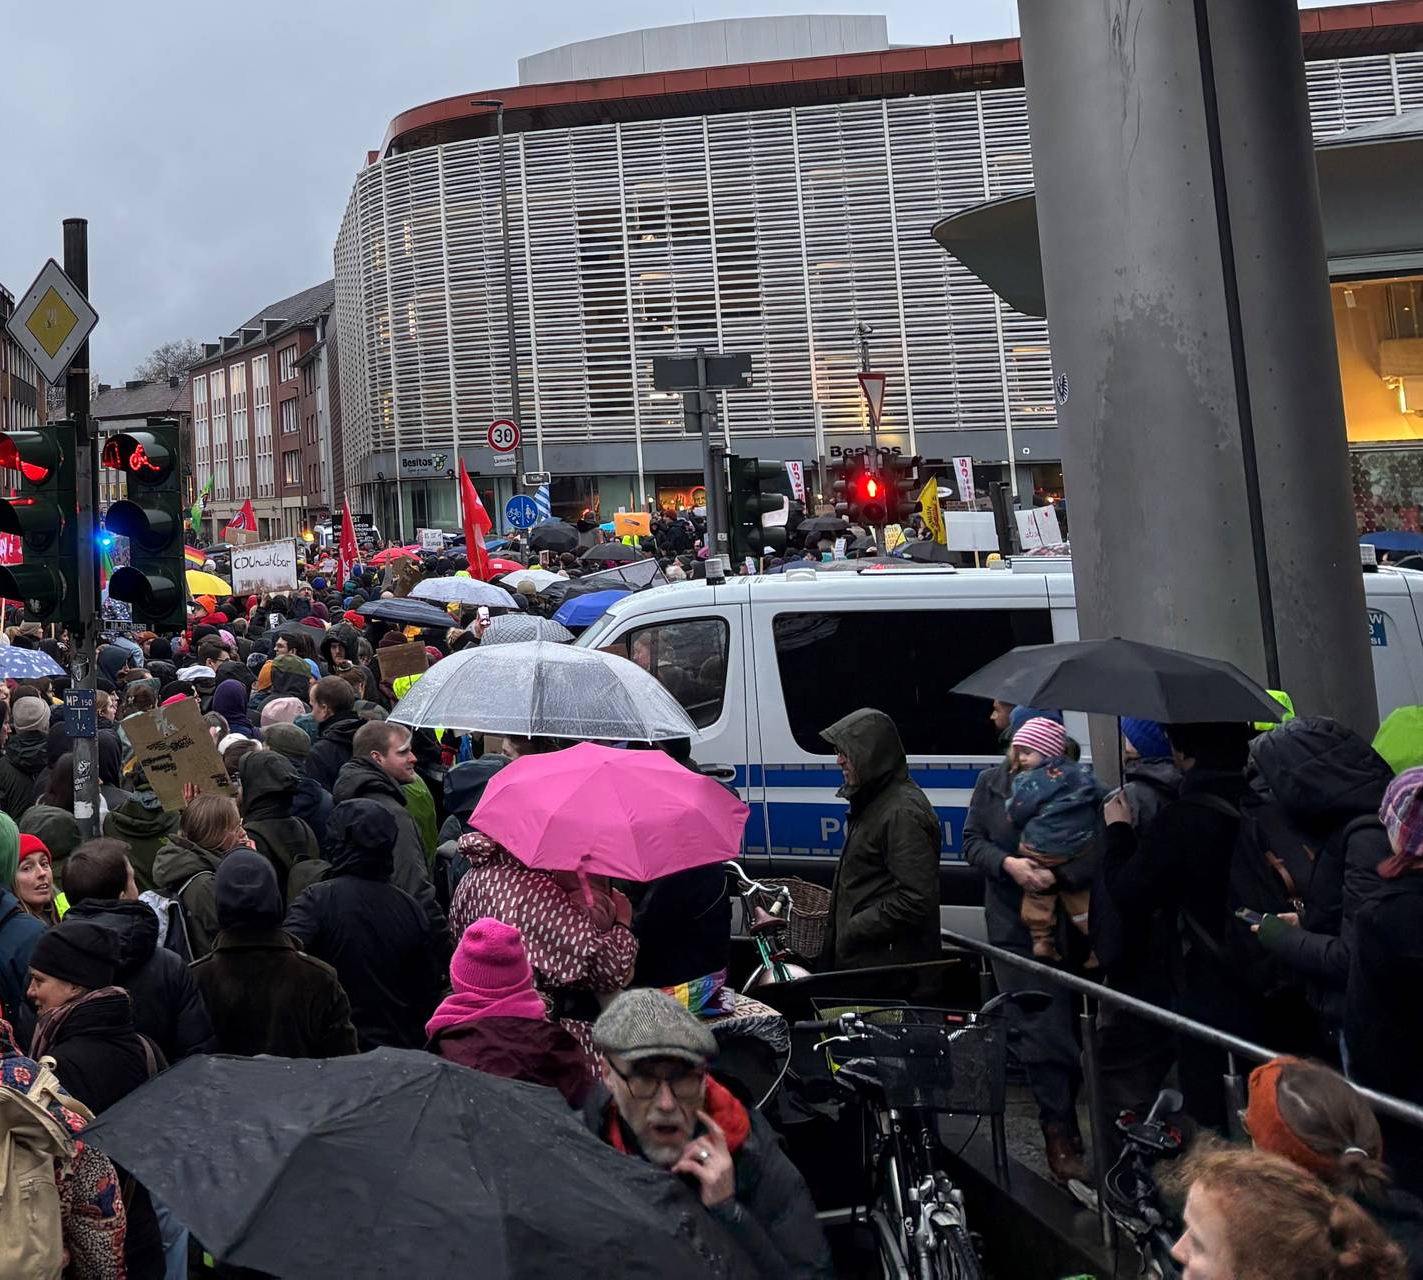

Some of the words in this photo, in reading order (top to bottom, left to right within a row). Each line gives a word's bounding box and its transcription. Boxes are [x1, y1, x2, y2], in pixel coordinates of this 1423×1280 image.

[494, 428, 513, 443] 30
[402, 457, 433, 467] Besitos
[66, 695, 79, 707] MP
[81, 698, 93, 707] 150
